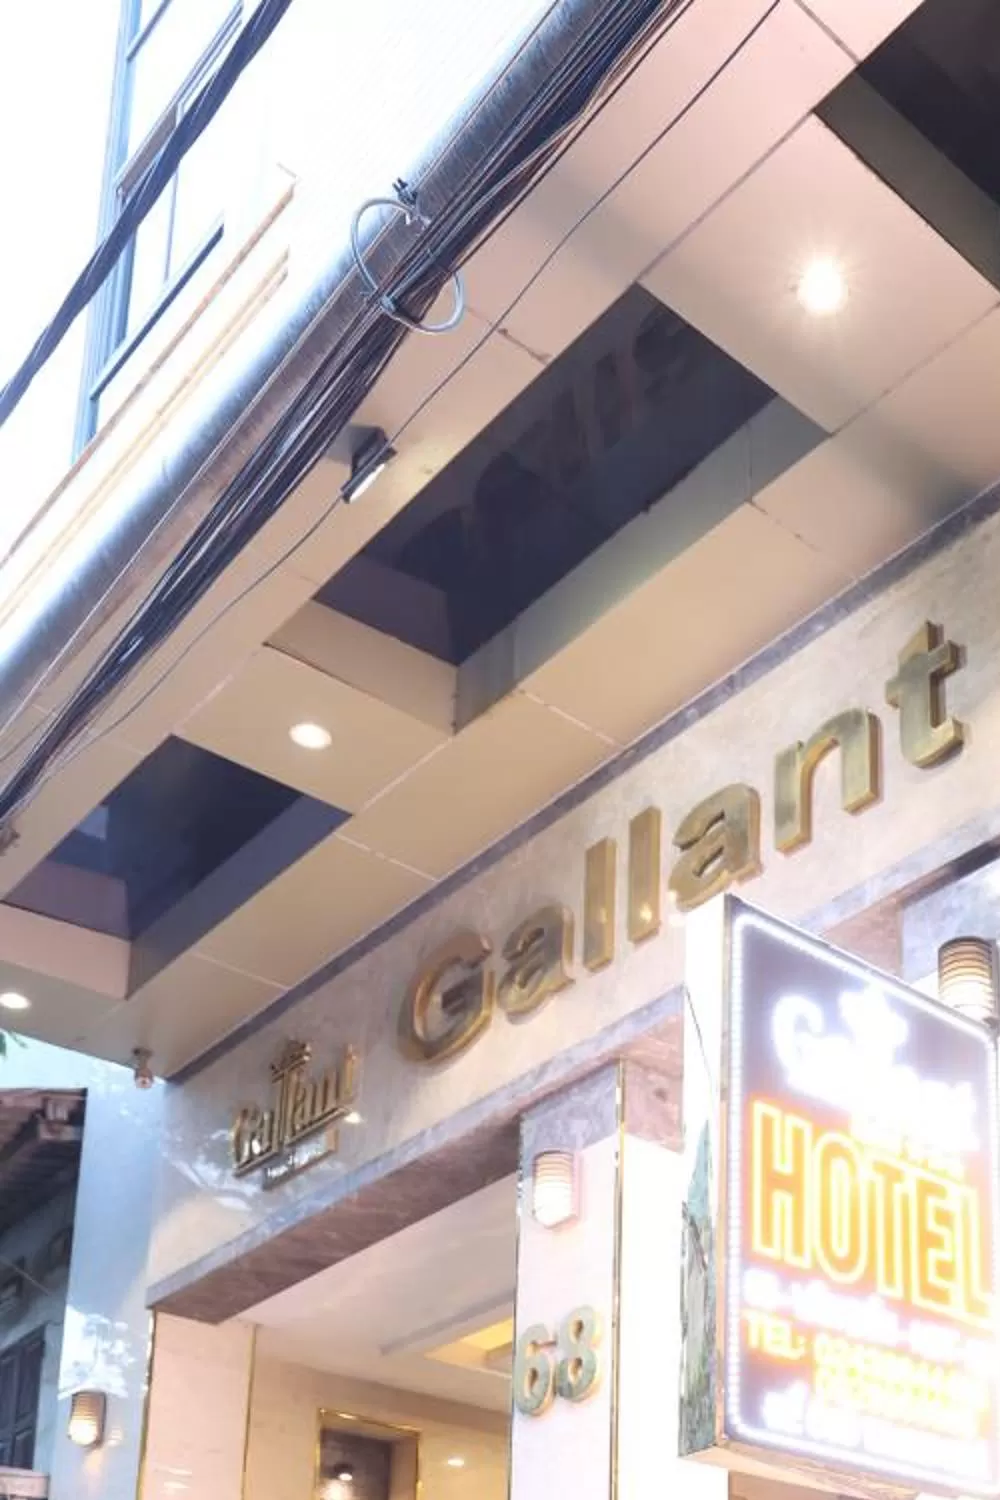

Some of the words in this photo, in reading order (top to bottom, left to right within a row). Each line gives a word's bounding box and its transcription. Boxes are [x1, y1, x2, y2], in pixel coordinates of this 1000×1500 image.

[403, 619, 968, 1064] Gallant
[749, 1101, 994, 1330] HOTEL
[513, 1305, 602, 1417] 68
